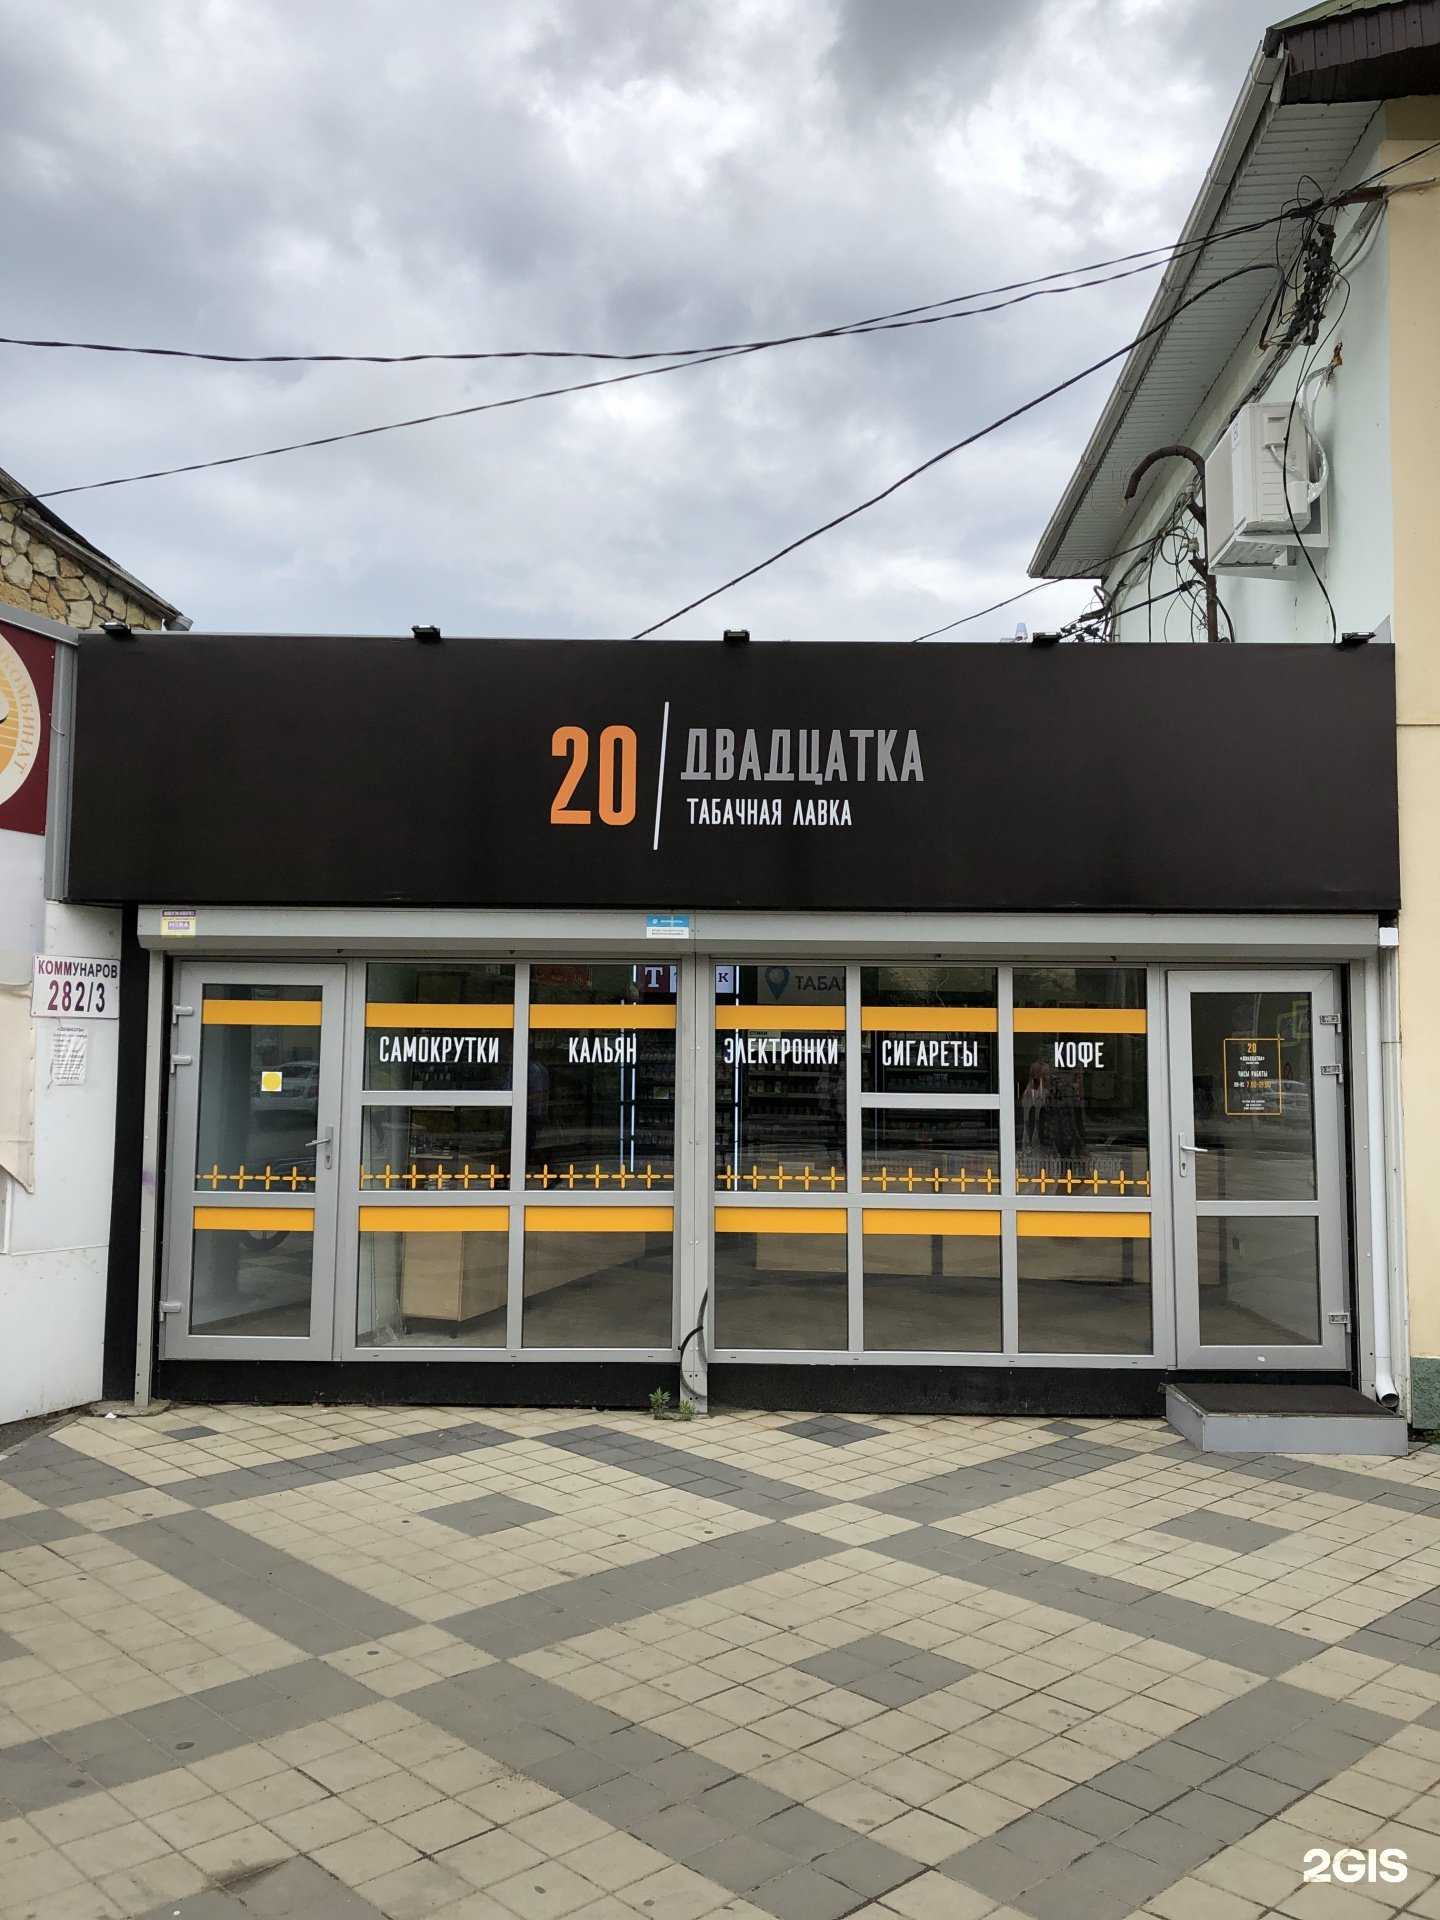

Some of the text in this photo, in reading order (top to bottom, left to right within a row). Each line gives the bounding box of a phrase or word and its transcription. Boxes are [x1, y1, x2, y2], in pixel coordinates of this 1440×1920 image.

[680, 728, 924, 785] ДВАДЦАТКА
[551, 725, 637, 826] 20
[686, 798, 852, 826] ТАБАЧНАЯ ЛАВКА
[38, 960, 118, 978] КОММУНАРОВ
[47, 980, 105, 1013] 282/3
[379, 1036, 499, 1063] САМОКРУТКИ
[568, 1037, 637, 1064] КАЛЬЯН
[724, 1038, 838, 1065] ЭЛЕКТРОНКИ
[882, 1040, 978, 1067] СИГАРЕТЫ
[1054, 1042, 1104, 1068] КОФЕ
[1247, 1042, 1257, 1053] 20
